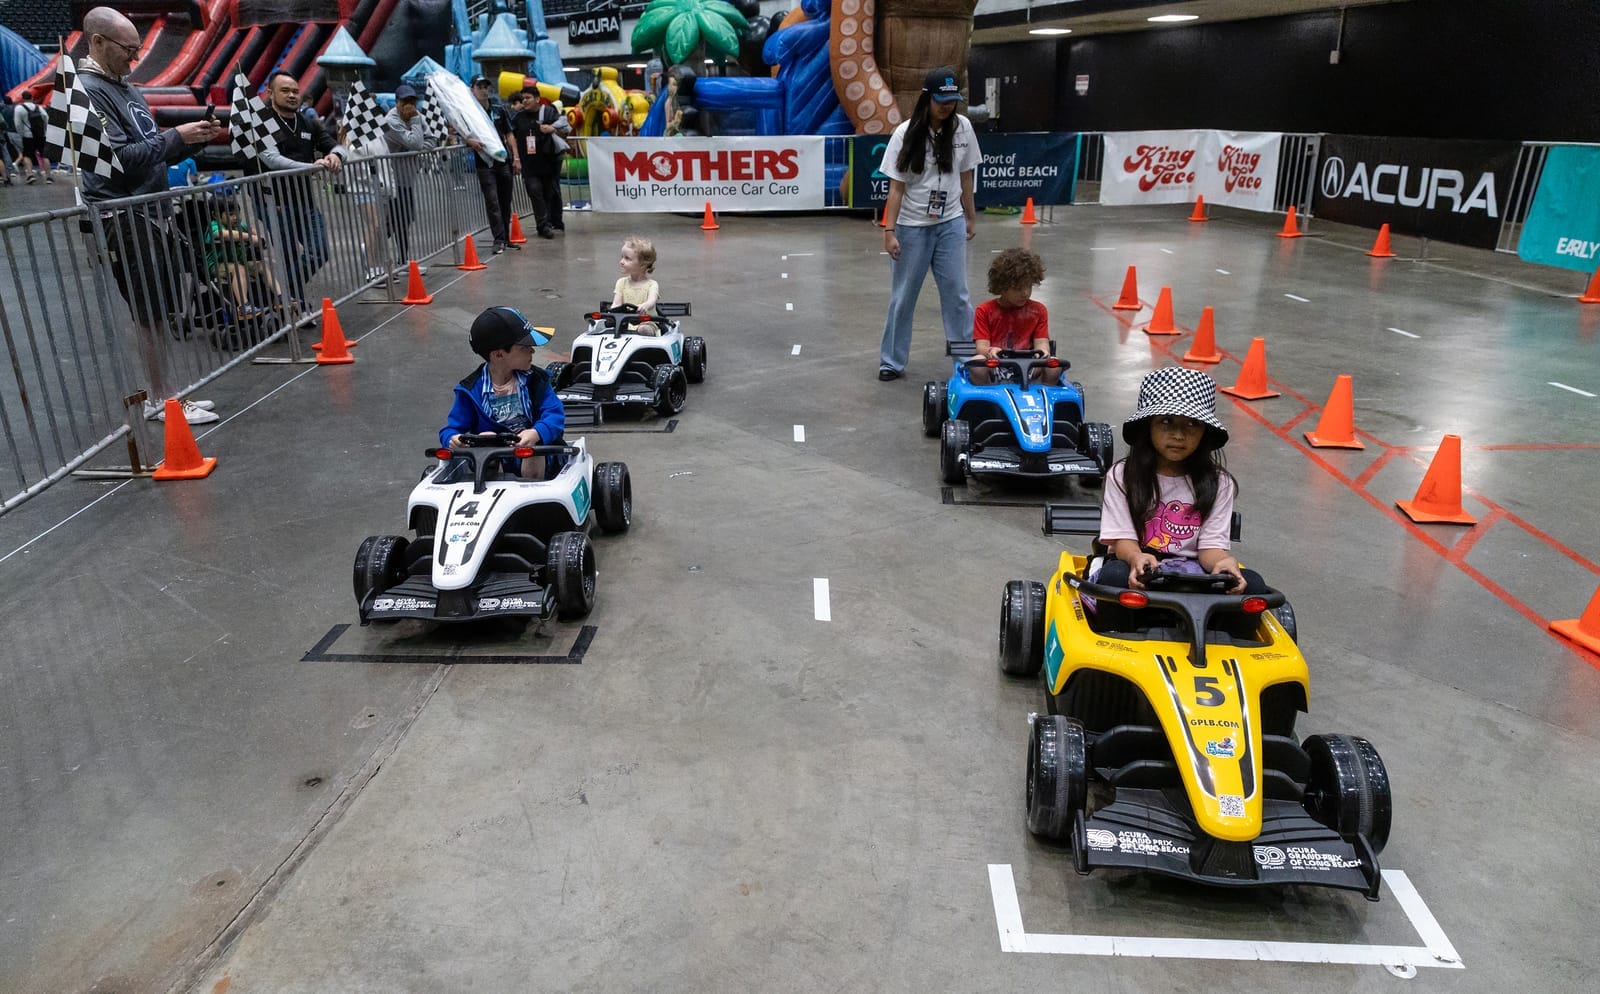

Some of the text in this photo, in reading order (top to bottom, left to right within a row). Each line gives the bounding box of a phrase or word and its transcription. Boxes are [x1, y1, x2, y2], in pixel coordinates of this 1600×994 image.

[577, 16, 619, 36] ACURA
[613, 149, 799, 182] MOTHERS
[983, 153, 1016, 165] Port of
[1124, 145, 1195, 173] King
[1218, 145, 1261, 174] King
[982, 166, 1058, 177] LONG BEACH
[1139, 164, 1195, 192] Taco
[1225, 166, 1262, 193] Taco
[615, 182, 799, 199] High Performance Car Care
[983, 180, 997, 188] THE
[998, 180, 1022, 188] GREEN
[1343, 162, 1499, 218] ACURA
[1556, 237, 1600, 259] EARLY
[604, 341, 617, 349] 6
[1022, 395, 1036, 407] 1
[455, 501, 480, 518] 4
[1194, 676, 1225, 707] 5
[1190, 719, 1239, 729] GPLB.COM
[1118, 831, 1148, 839] ACURA
[1119, 837, 1173, 847] GRAND PRIX
[1134, 843, 1160, 852] LONG
[1160, 846, 1190, 854] BEACH
[1252, 846, 1286, 865] 50
[1303, 859, 1331, 867] LONG
[1331, 858, 1363, 868] BEACH
[1321, 854, 1343, 862] PRIX
